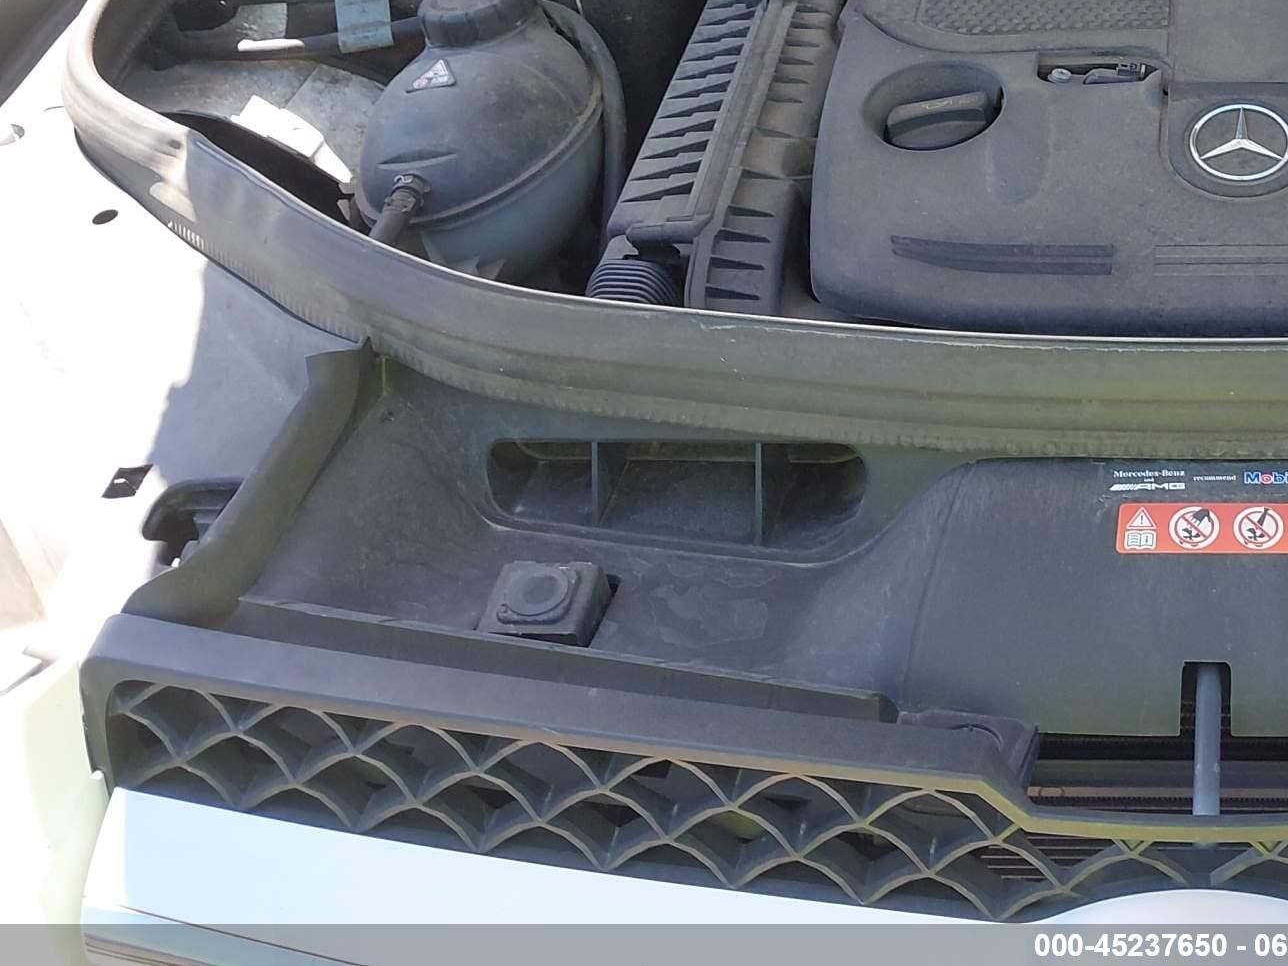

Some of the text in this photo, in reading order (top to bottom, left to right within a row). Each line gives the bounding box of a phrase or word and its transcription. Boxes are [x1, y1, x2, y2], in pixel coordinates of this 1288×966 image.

[1113, 469, 1185, 478] Mercedes-Benz
[1193, 474, 1237, 482] recommend
[1133, 482, 1186, 491] AMG
